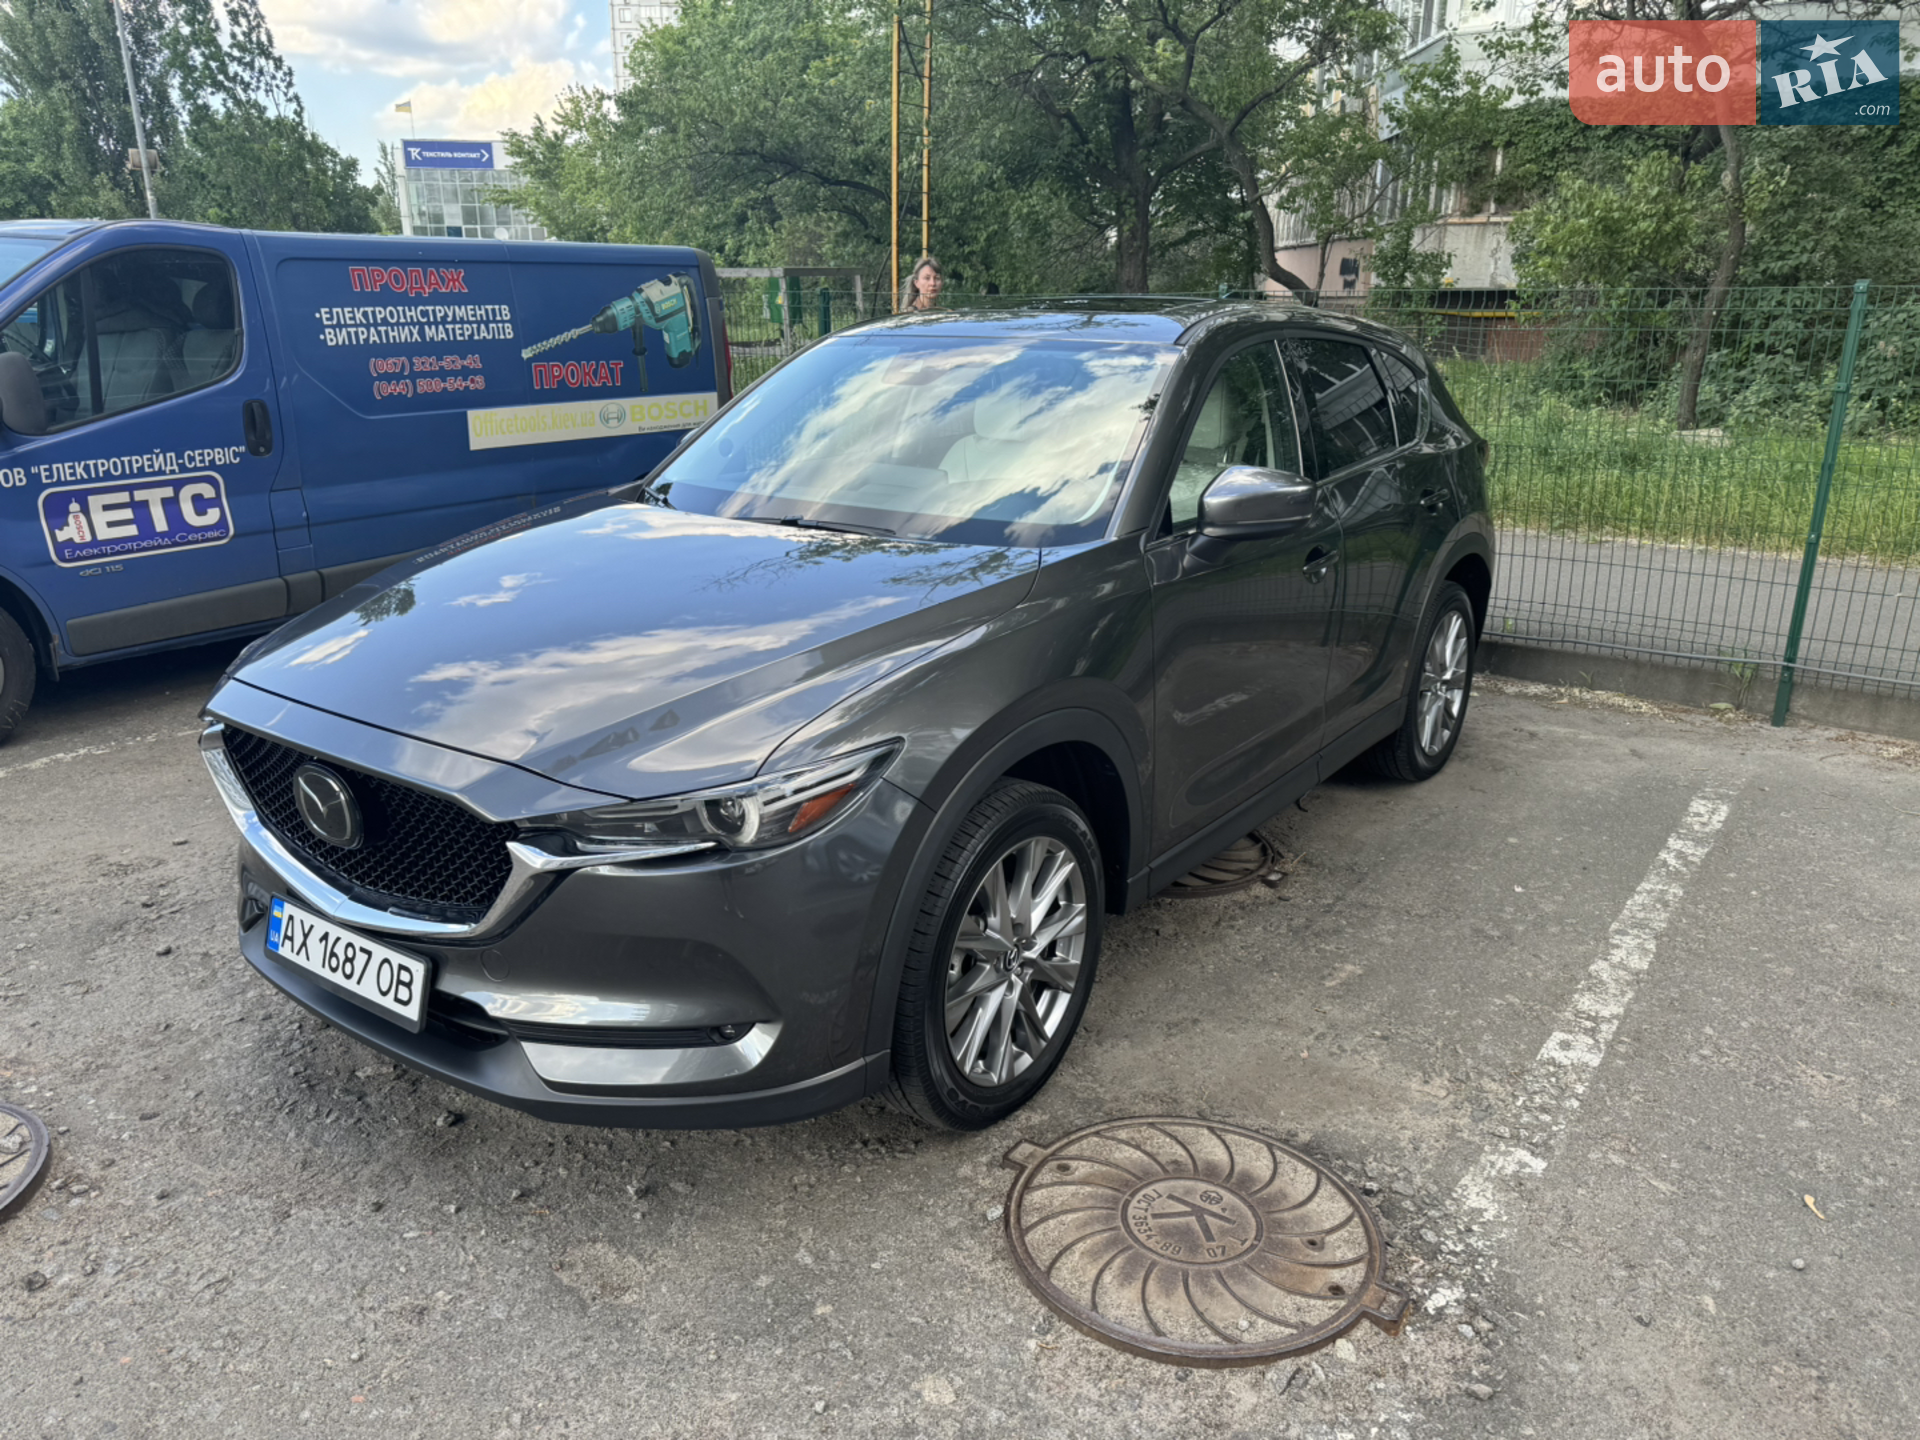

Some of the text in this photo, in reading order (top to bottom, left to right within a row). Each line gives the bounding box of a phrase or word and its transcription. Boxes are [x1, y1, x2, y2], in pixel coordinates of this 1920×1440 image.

[349, 266, 468, 296] ПРОДАЖ
[319, 304, 511, 325] ЕЛЕКТРОІНСТРУМЕНТІВ
[661, 298, 677, 311] BOSCH
[324, 323, 514, 346] ВИТРАТНИХ МАТЕРІАЛІВ
[369, 356, 410, 377] (067)
[532, 360, 624, 389] ПРОКАТ
[373, 379, 414, 400] (044)
[629, 399, 709, 423] BOSCH
[472, 408, 595, 438] Officetools.kiev.ua
[72, 514, 87, 541] BOSCH
[105, 564, 124, 573] 115
[270, 930, 279, 944] UA
[318, 931, 373, 986] 1687
